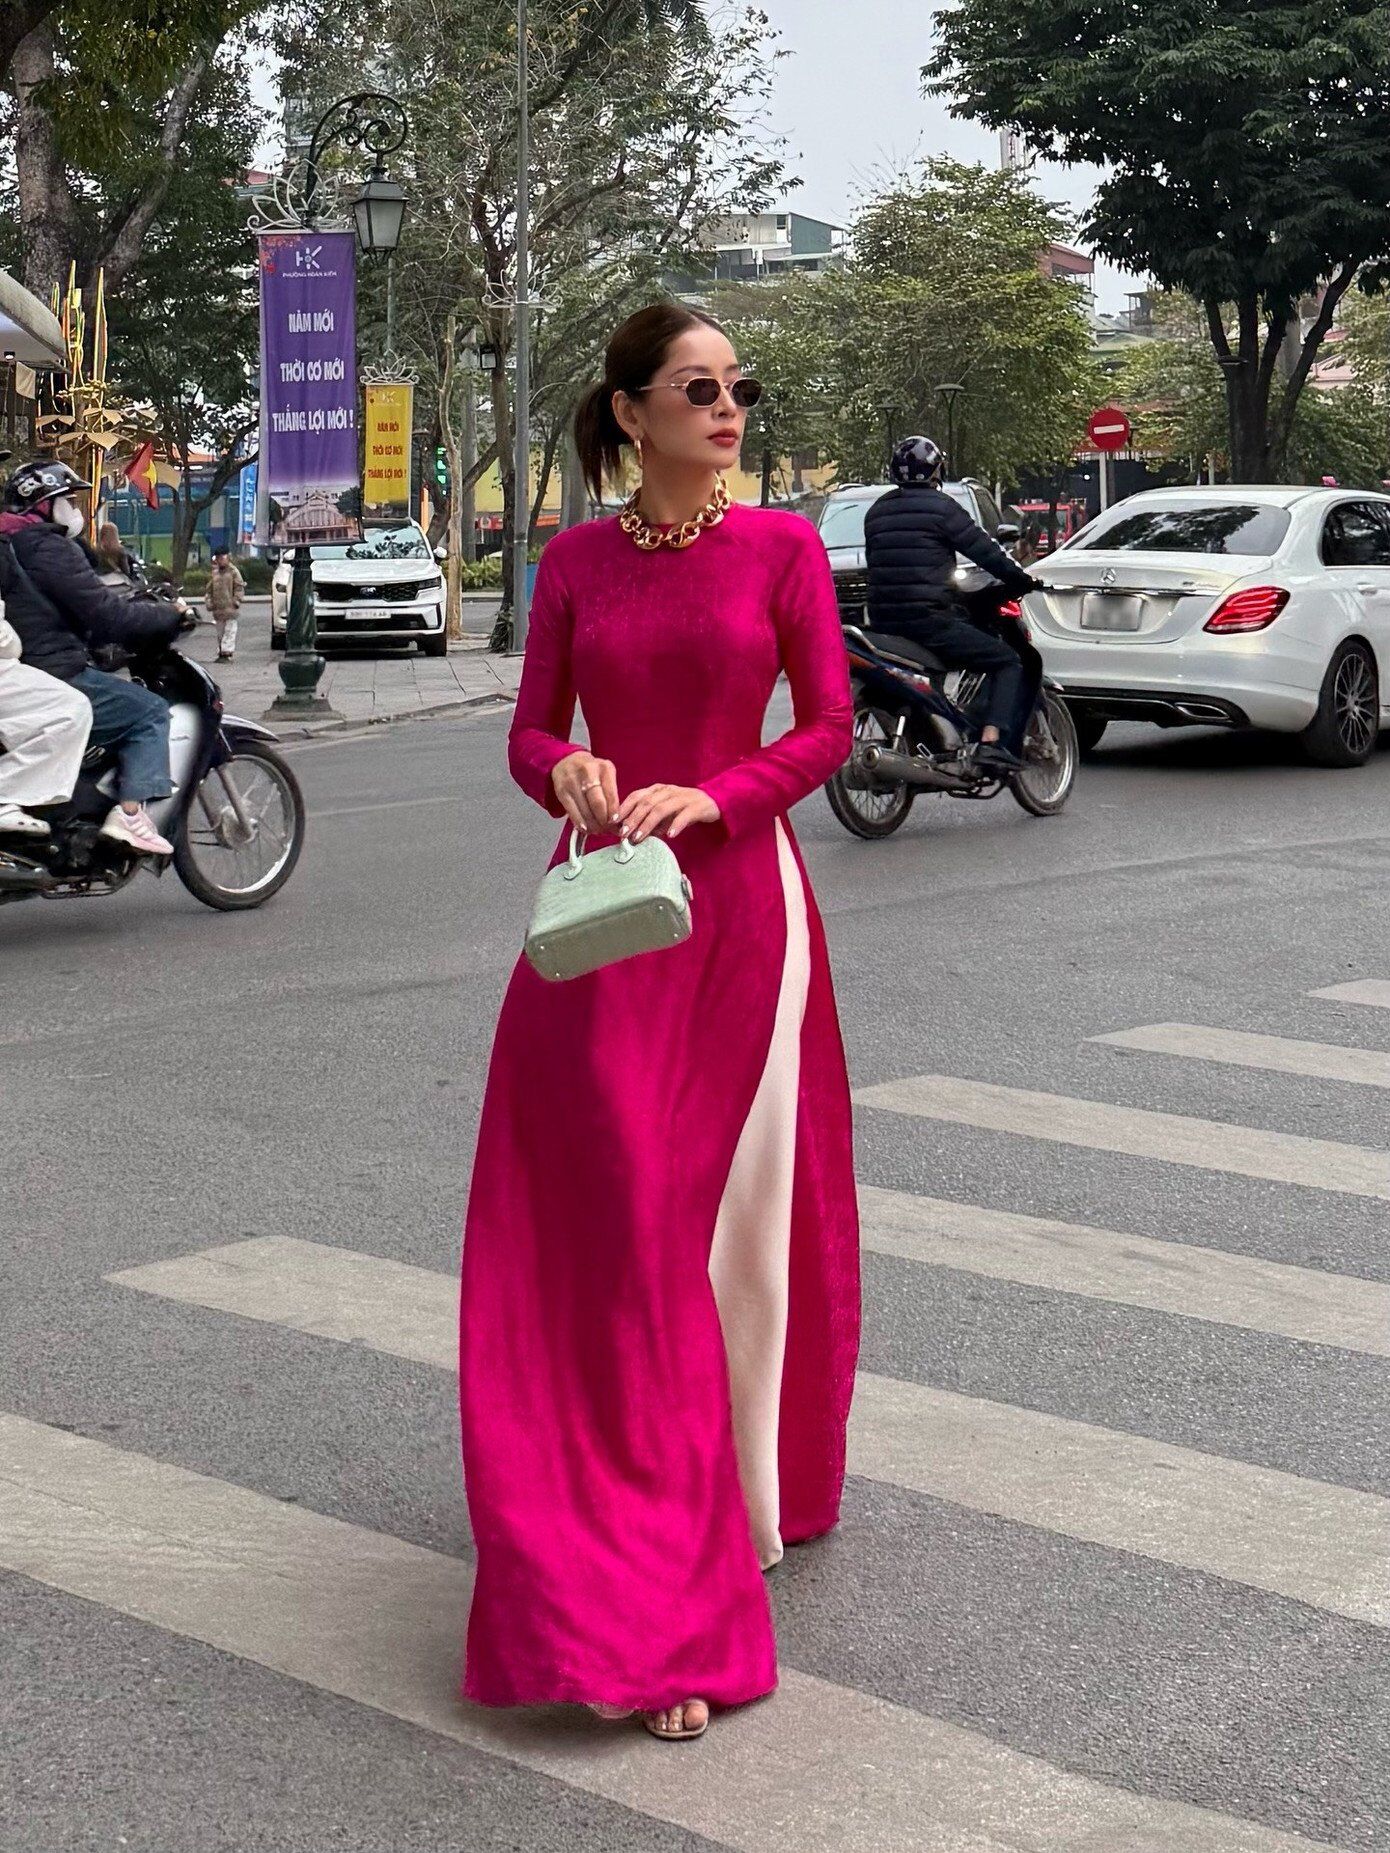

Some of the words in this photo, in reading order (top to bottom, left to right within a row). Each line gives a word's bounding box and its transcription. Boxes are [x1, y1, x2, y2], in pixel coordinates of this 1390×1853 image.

[313, 308, 334, 332] MỚI
[280, 358, 305, 382] THỜI
[307, 359, 322, 381] CƠ
[323, 357, 345, 381] MỚI
[272, 403, 307, 432] THẮNG
[308, 408, 325, 435] LỢI
[327, 406, 347, 430] MỚI
